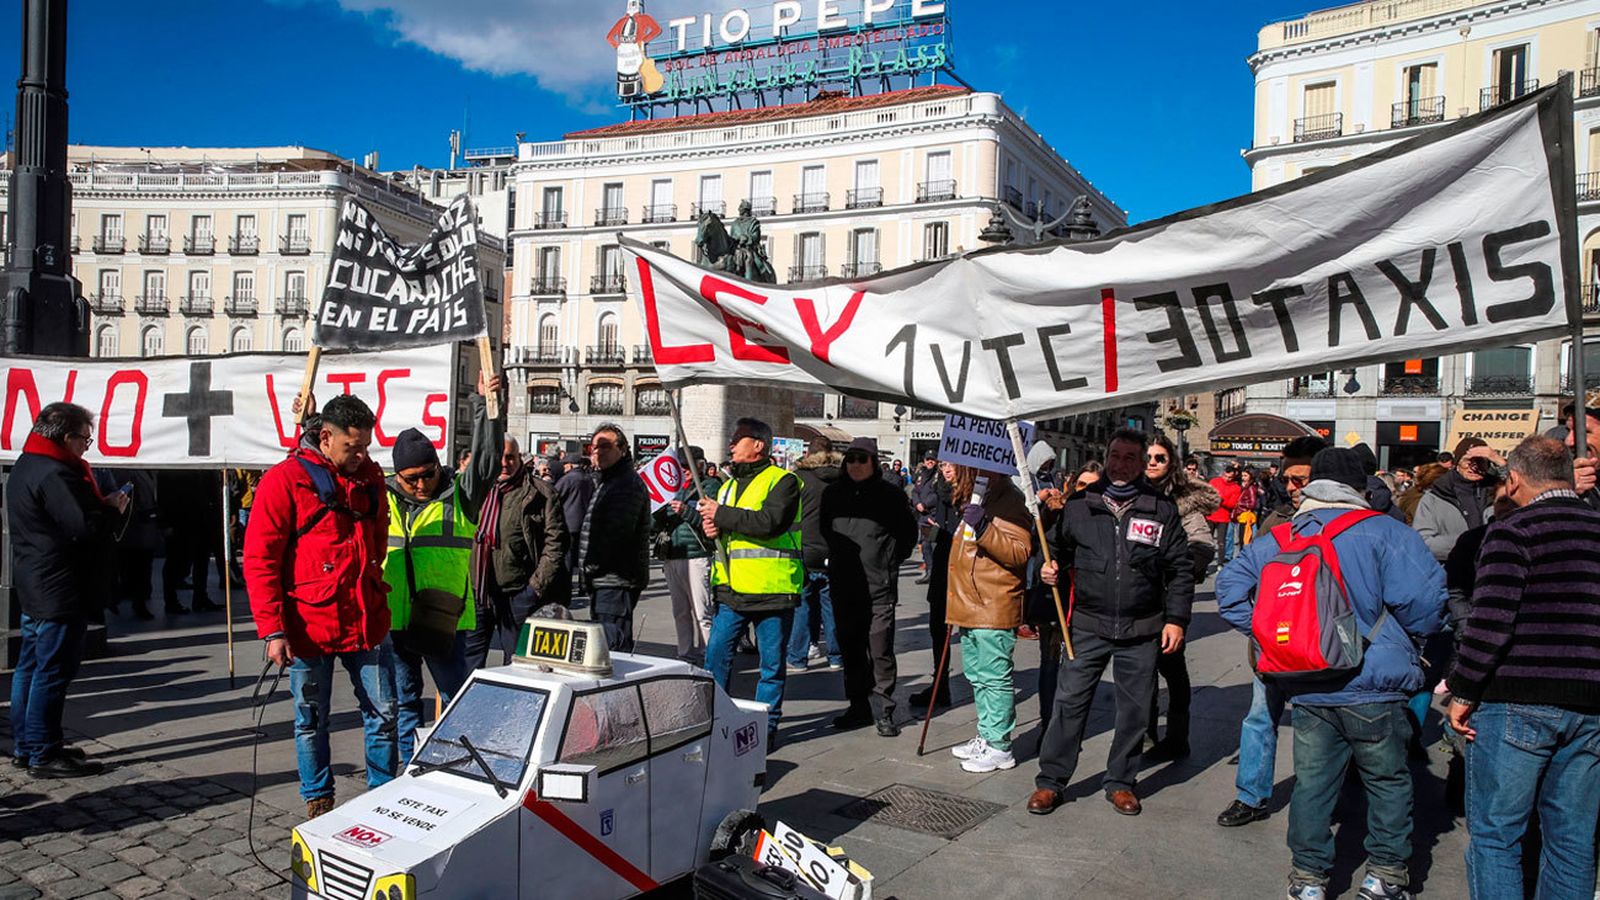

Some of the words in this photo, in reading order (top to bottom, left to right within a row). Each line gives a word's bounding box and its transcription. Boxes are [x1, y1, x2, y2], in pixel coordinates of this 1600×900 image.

[669, 9, 750, 50] TIO
[773, 0, 946, 36] PEPE
[665, 59, 694, 72] SOL
[700, 52, 717, 67] DE
[817, 23, 944, 51] EMBOTELLADO
[342, 201, 368, 229] NO
[321, 301, 361, 328] EN
[368, 306, 399, 332] EL
[636, 256, 866, 367] LEY
[1, 368, 148, 457] NO
[950, 415, 966, 430] LA
[1462, 413, 1530, 421] CHANGE
[639, 437, 667, 445] PRIMOR
[945, 437, 959, 453] MI
[1218, 442, 1231, 450] TOP
[1232, 442, 1253, 450] TOURS
[1457, 431, 1525, 439] TRANSFER
[535, 630, 568, 656] TAXI
[372, 806, 389, 815] NO
[387, 811, 403, 820] SE
[402, 815, 437, 831] VENDE
[398, 797, 421, 809] ESTE
[422, 804, 448, 817] TAXI
